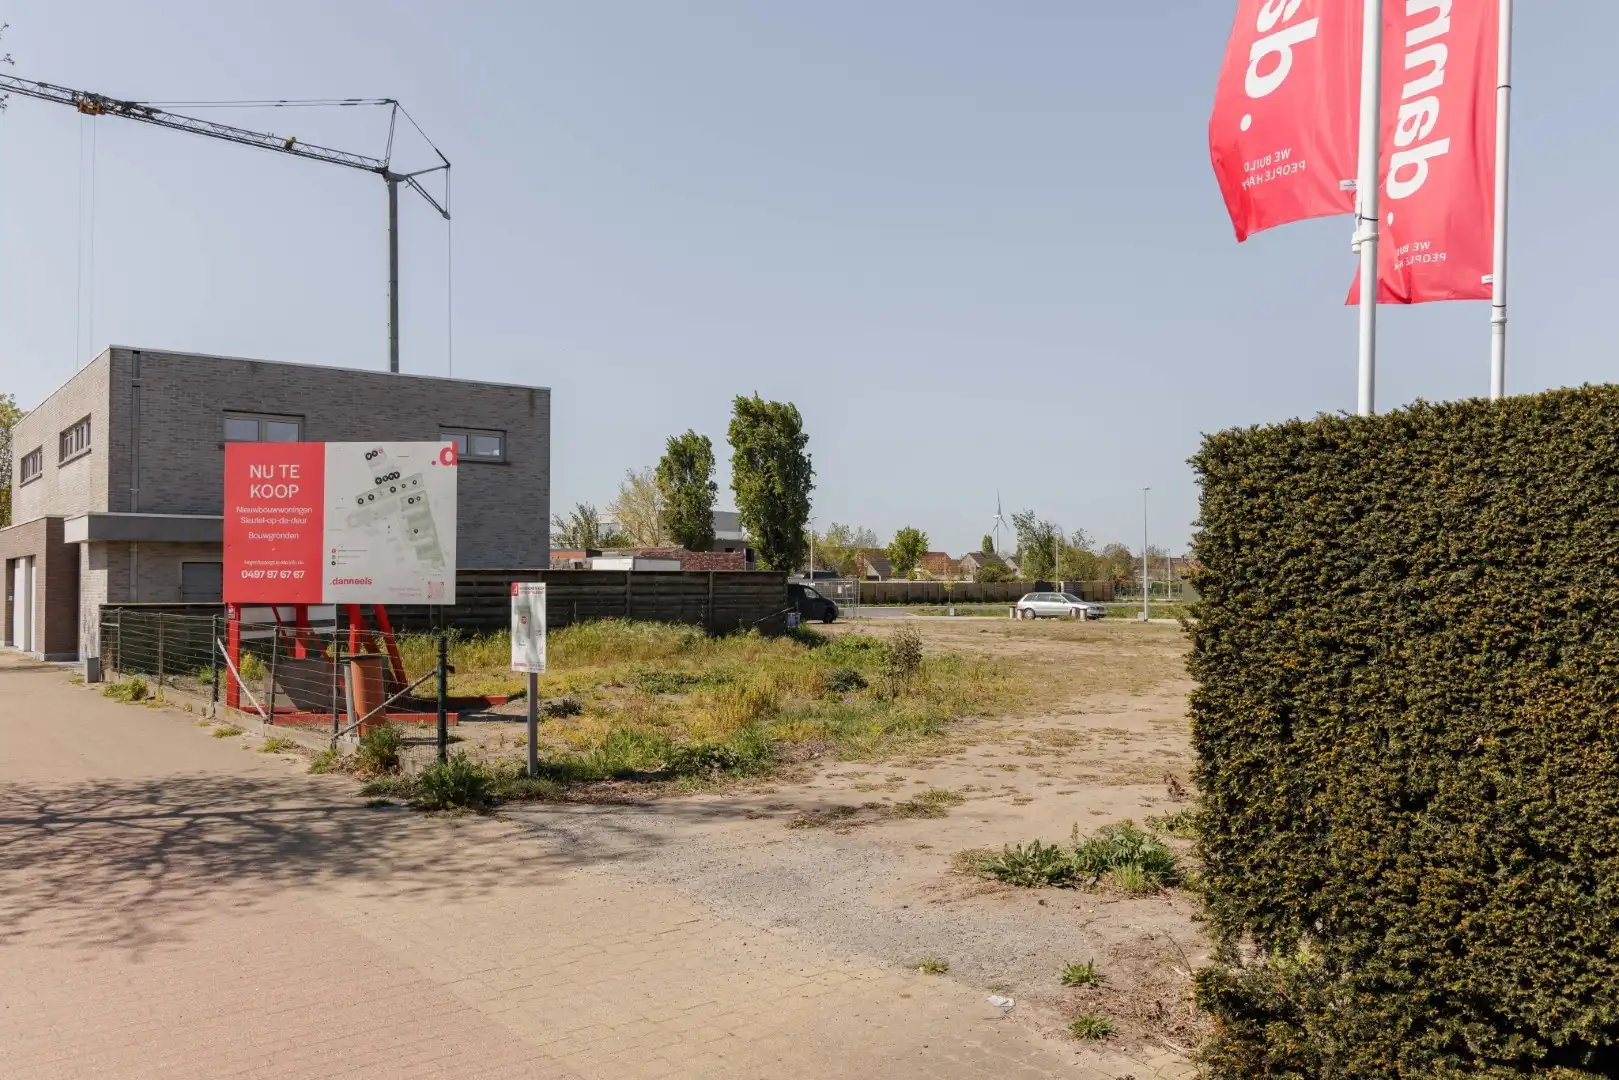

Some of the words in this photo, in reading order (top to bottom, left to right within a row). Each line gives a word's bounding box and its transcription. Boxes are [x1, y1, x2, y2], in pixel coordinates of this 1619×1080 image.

[431, 441, 458, 467] .d
[249, 464, 275, 479] NU
[279, 464, 300, 479] TE
[250, 484, 300, 499] KOOP
[236, 505, 313, 515] Nieuwbouwwoningen
[240, 516, 308, 525] Sleutel-op-de-deur
[248, 531, 299, 541] Bouwgronden
[241, 569, 265, 579] 0497
[279, 569, 292, 579] 67
[293, 569, 305, 579] 67
